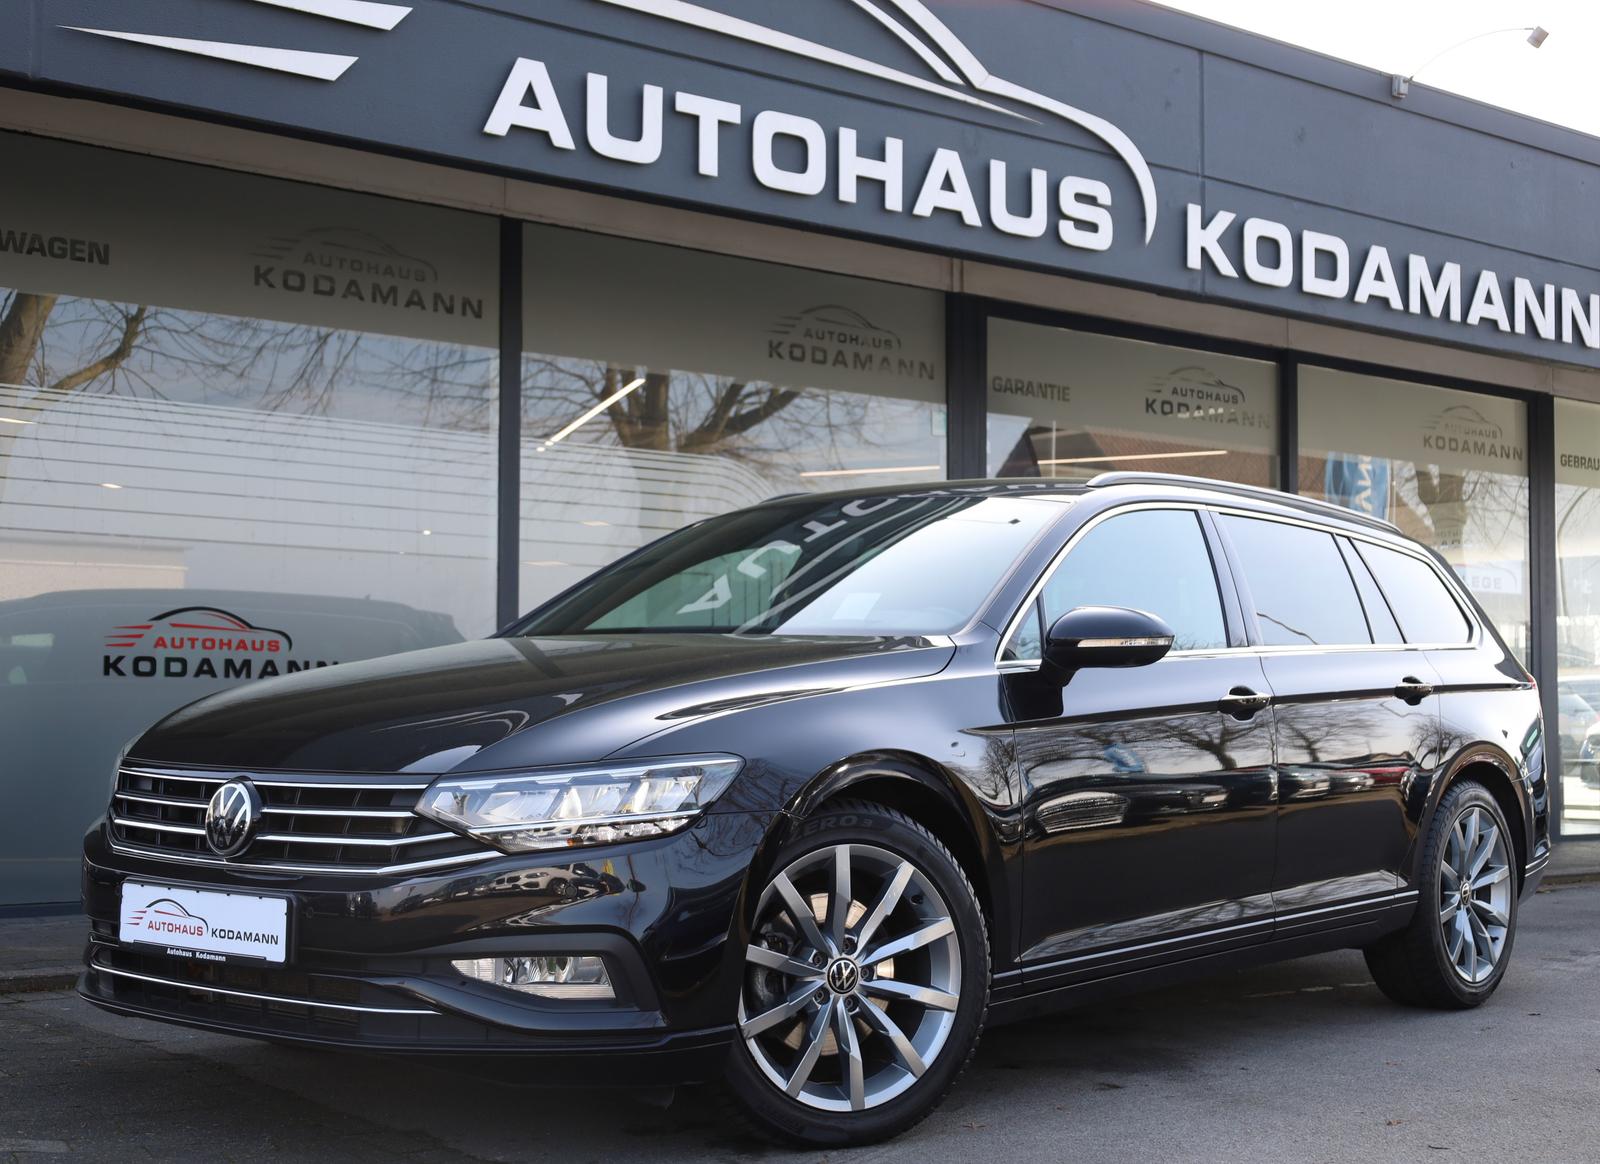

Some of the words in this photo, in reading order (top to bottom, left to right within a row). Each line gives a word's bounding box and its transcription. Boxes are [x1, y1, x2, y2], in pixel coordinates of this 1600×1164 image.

[483, 57, 1114, 252] AUTOHAUS
[1186, 203, 1600, 349] KODAMANN
[0, 227, 111, 266] WAGEN
[302, 251, 426, 283] AUTOHAUS
[253, 264, 483, 319] KODAMANN
[803, 327, 893, 350] AUTOHAUS
[768, 339, 935, 380] KODAMANN
[992, 375, 1071, 403] GARANTIE
[1171, 386, 1239, 405] AUTOHAUS
[1444, 422, 1498, 440] AUOHAUS
[1423, 435, 1523, 461] KODAMANN
[1560, 453, 1600, 471] GEBRAU
[153, 636, 281, 652] AUTOHAUS
[147, 920, 204, 937] AUTOHAUS
[211, 928, 279, 945] KODAMANN
[167, 947, 193, 958] Autohaus
[195, 951, 226, 962] Kodamann
